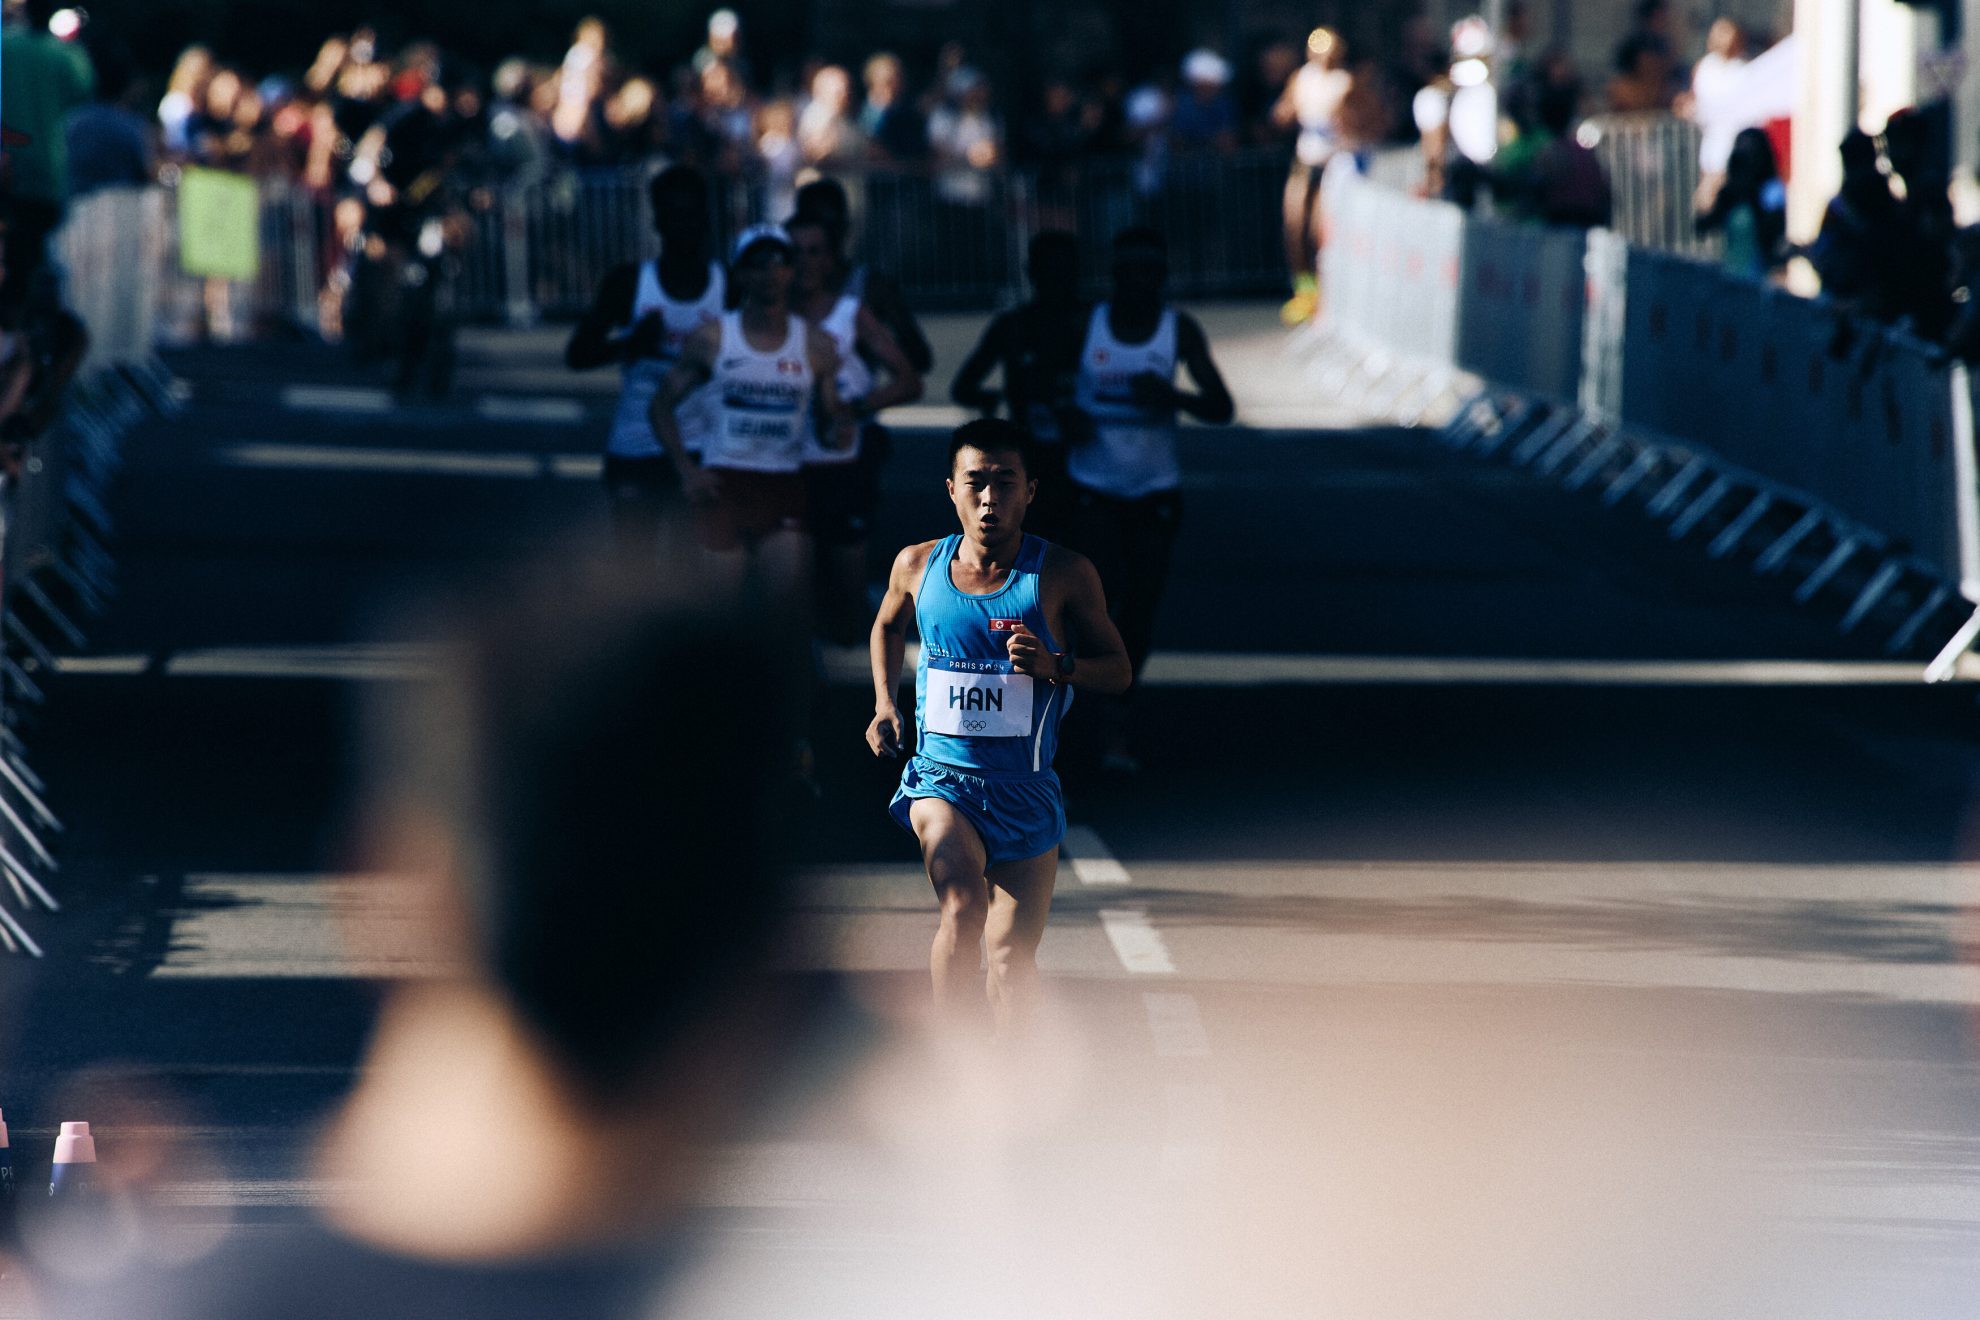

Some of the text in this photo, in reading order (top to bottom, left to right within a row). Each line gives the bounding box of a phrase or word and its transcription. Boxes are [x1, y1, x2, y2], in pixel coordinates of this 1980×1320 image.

[949, 660, 1005, 671] PARIS 2024
[949, 686, 1003, 712] HAN
